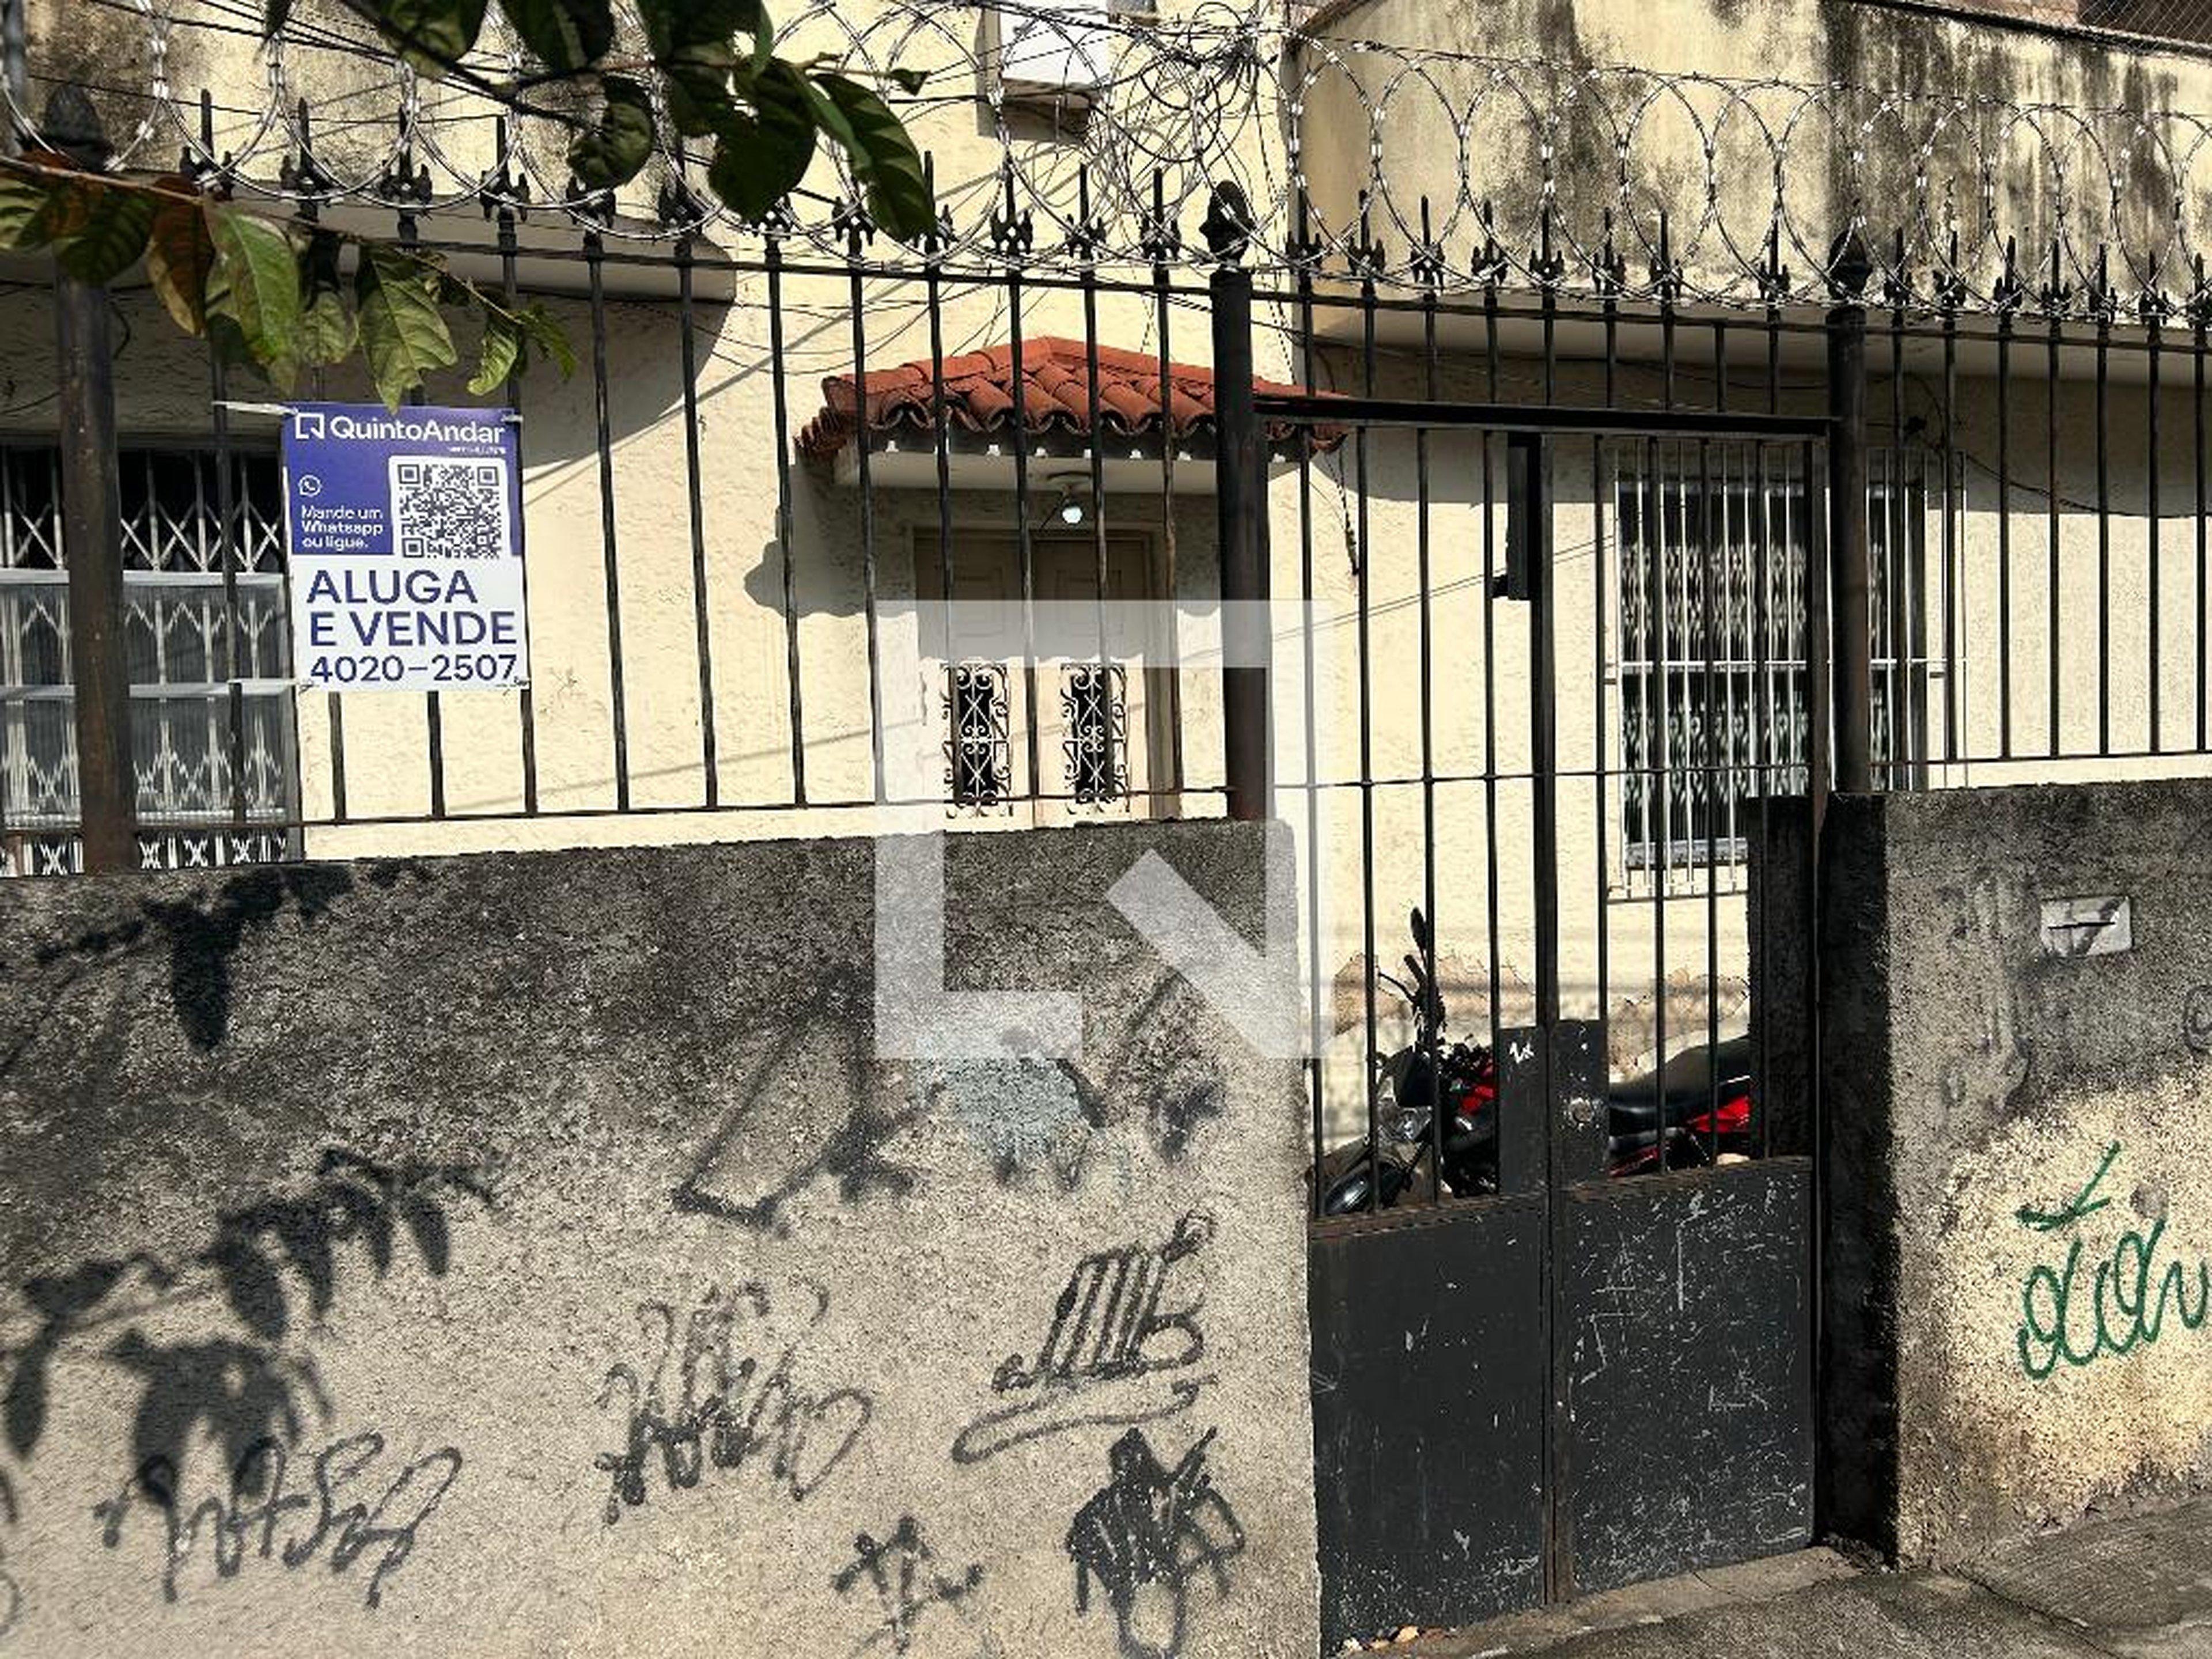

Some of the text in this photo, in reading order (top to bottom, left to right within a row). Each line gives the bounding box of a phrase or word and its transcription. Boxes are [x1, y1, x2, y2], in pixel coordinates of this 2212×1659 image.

[330, 416, 506, 444] QuintoAndar
[301, 505, 383, 518] Mande um
[301, 521, 384, 536] Whatsapp
[302, 536, 368, 551] ou ligue.
[306, 569, 478, 605] ALUGA
[310, 611, 517, 646] E VENDE
[310, 654, 517, 683] 4020-2507
